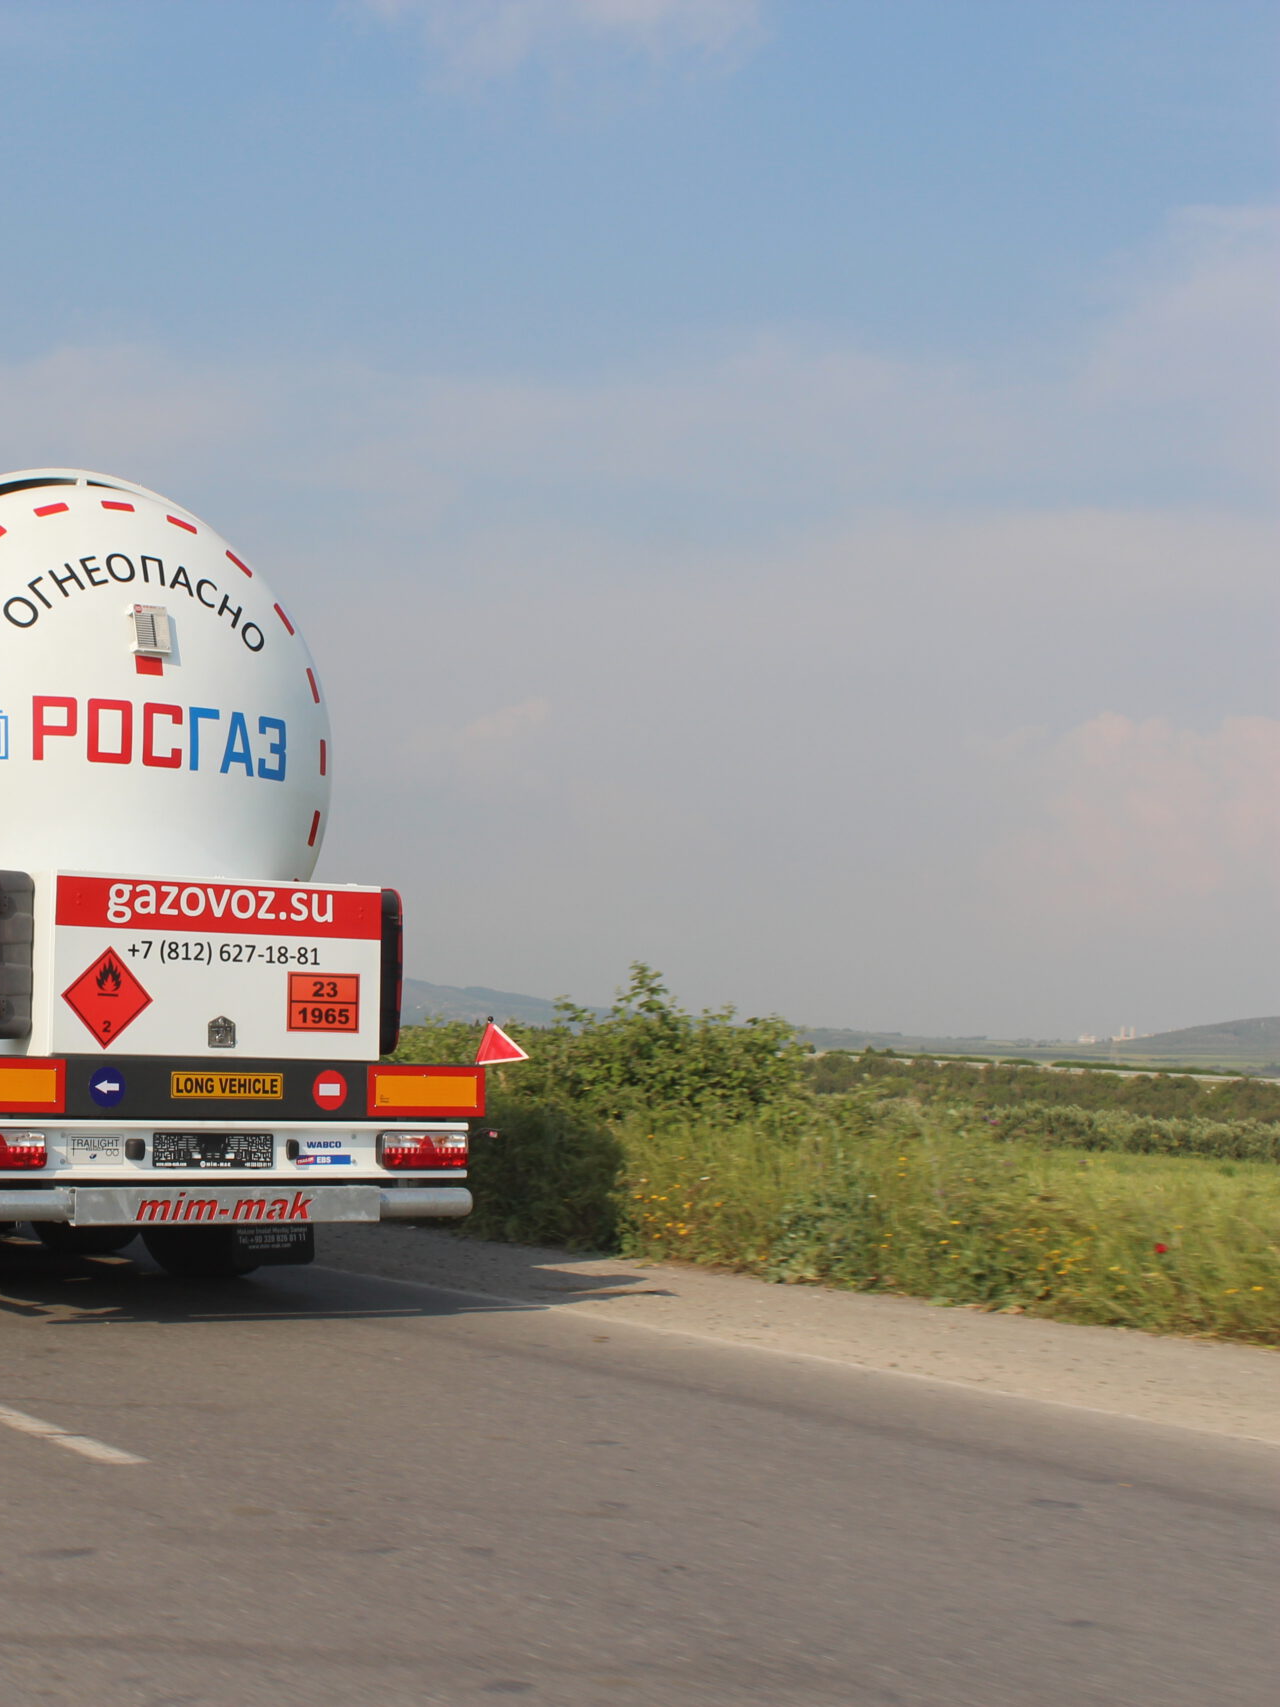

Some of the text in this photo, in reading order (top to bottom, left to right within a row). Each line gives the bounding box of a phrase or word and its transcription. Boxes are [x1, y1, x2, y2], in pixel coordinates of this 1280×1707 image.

[3, 553, 265, 652] ОГНЕОПАСНО
[32, 695, 287, 782] РОСГАЗ
[106, 882, 334, 924] gazovoz.su
[128, 939, 321, 966] +7 (812) 627-18-81
[312, 981, 339, 998] 23
[297, 1007, 350, 1025] 1965
[102, 1020, 112, 1033] 2
[175, 1077, 279, 1094] LONG VEHICLE
[71, 1138, 120, 1148] TRAILIGHT
[306, 1141, 342, 1149] WABCO
[316, 1156, 332, 1164] EBS
[136, 1192, 313, 1221] mim-mak
